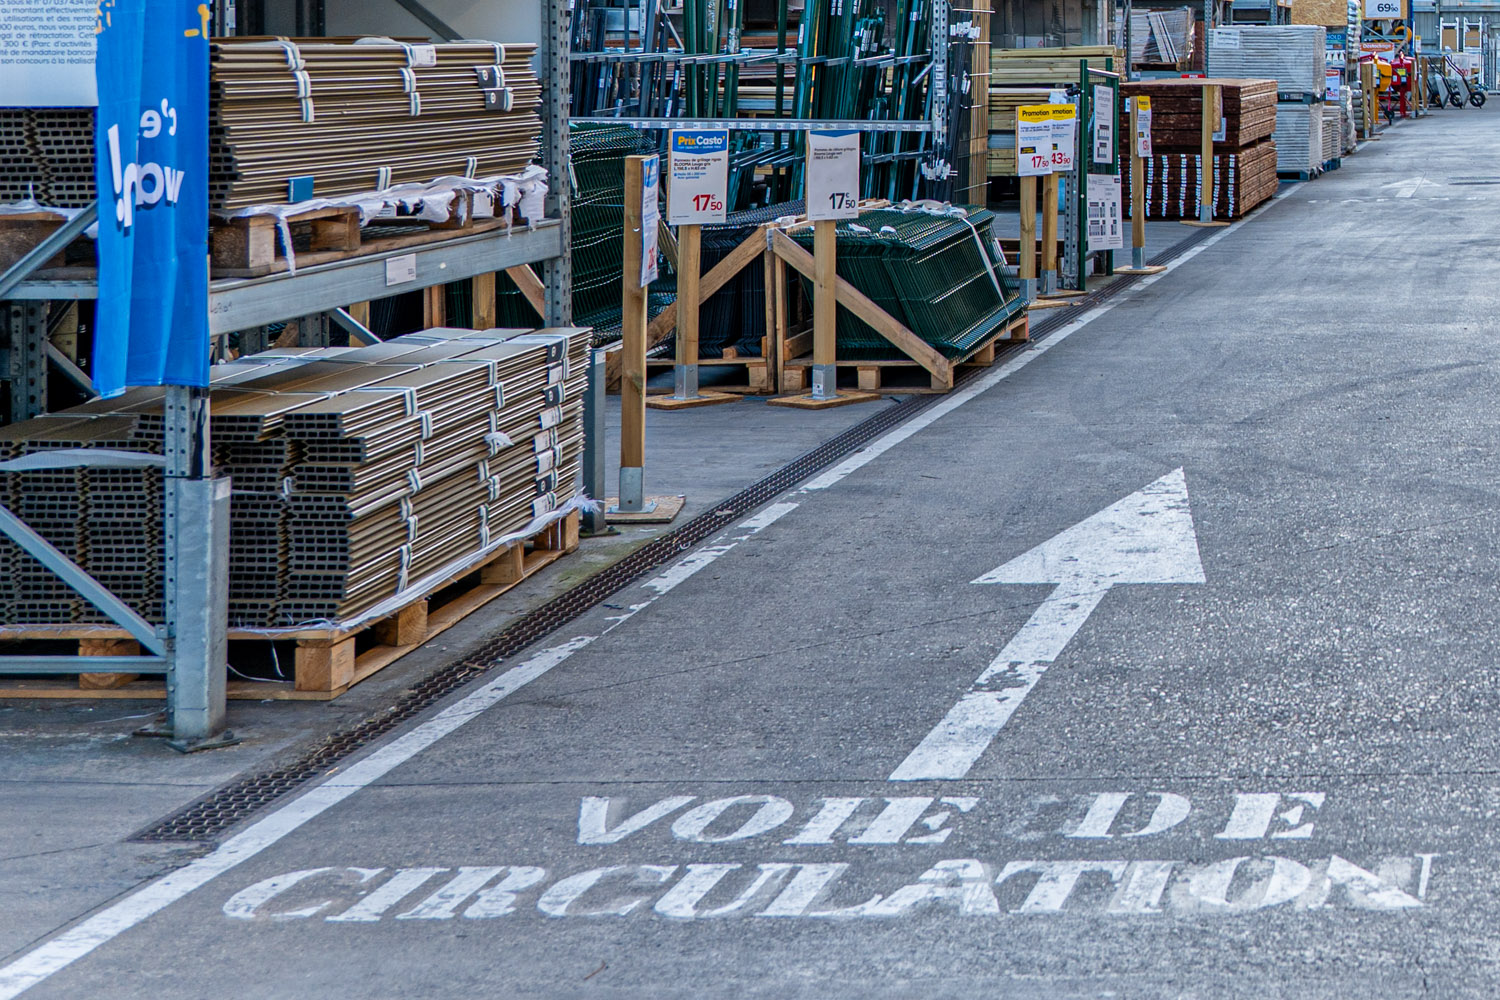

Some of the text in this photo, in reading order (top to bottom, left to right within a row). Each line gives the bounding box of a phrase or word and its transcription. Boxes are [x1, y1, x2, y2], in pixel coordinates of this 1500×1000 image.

[1022, 109, 1050, 117] Promotion
[577, 791, 1326, 845] VOIE DE
[223, 853, 1441, 922] CIRCULATION
